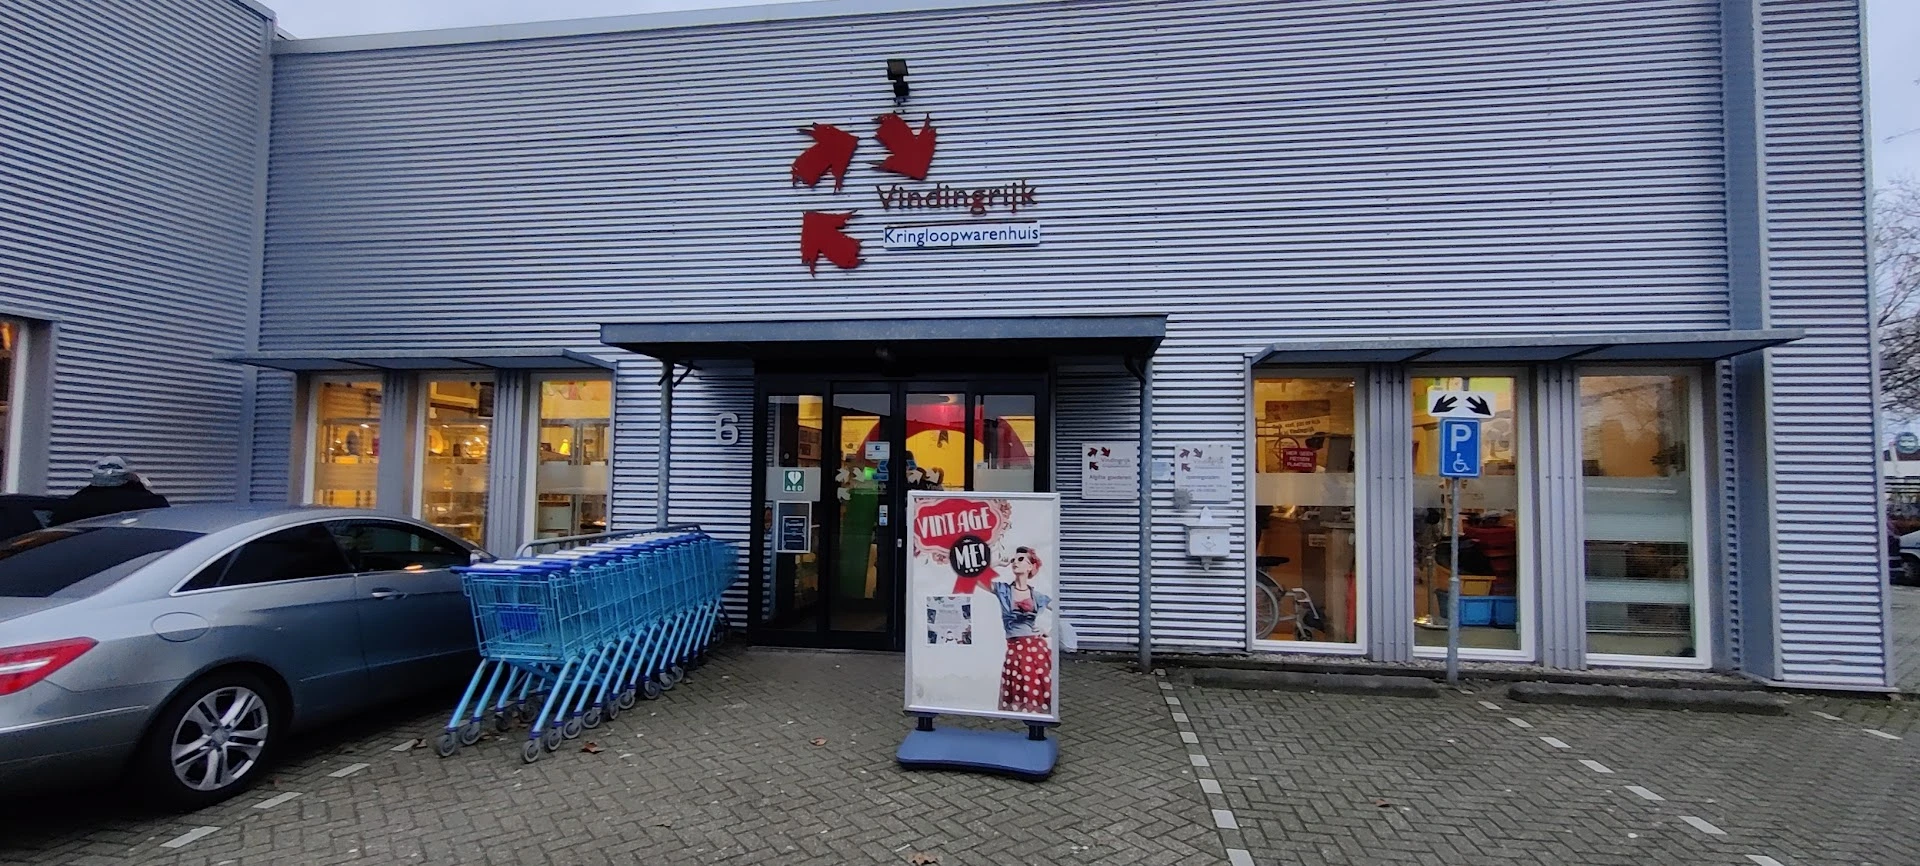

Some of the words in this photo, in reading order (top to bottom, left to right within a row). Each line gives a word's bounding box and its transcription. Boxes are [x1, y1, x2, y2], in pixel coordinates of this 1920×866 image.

[876, 179, 1037, 216] Vindingrijk
[884, 226, 1039, 246] Kringloopwarenhuis
[715, 412, 738, 445] 6
[1451, 424, 1472, 452] P
[916, 506, 992, 539] VINTAGE
[955, 542, 987, 570] ME!
